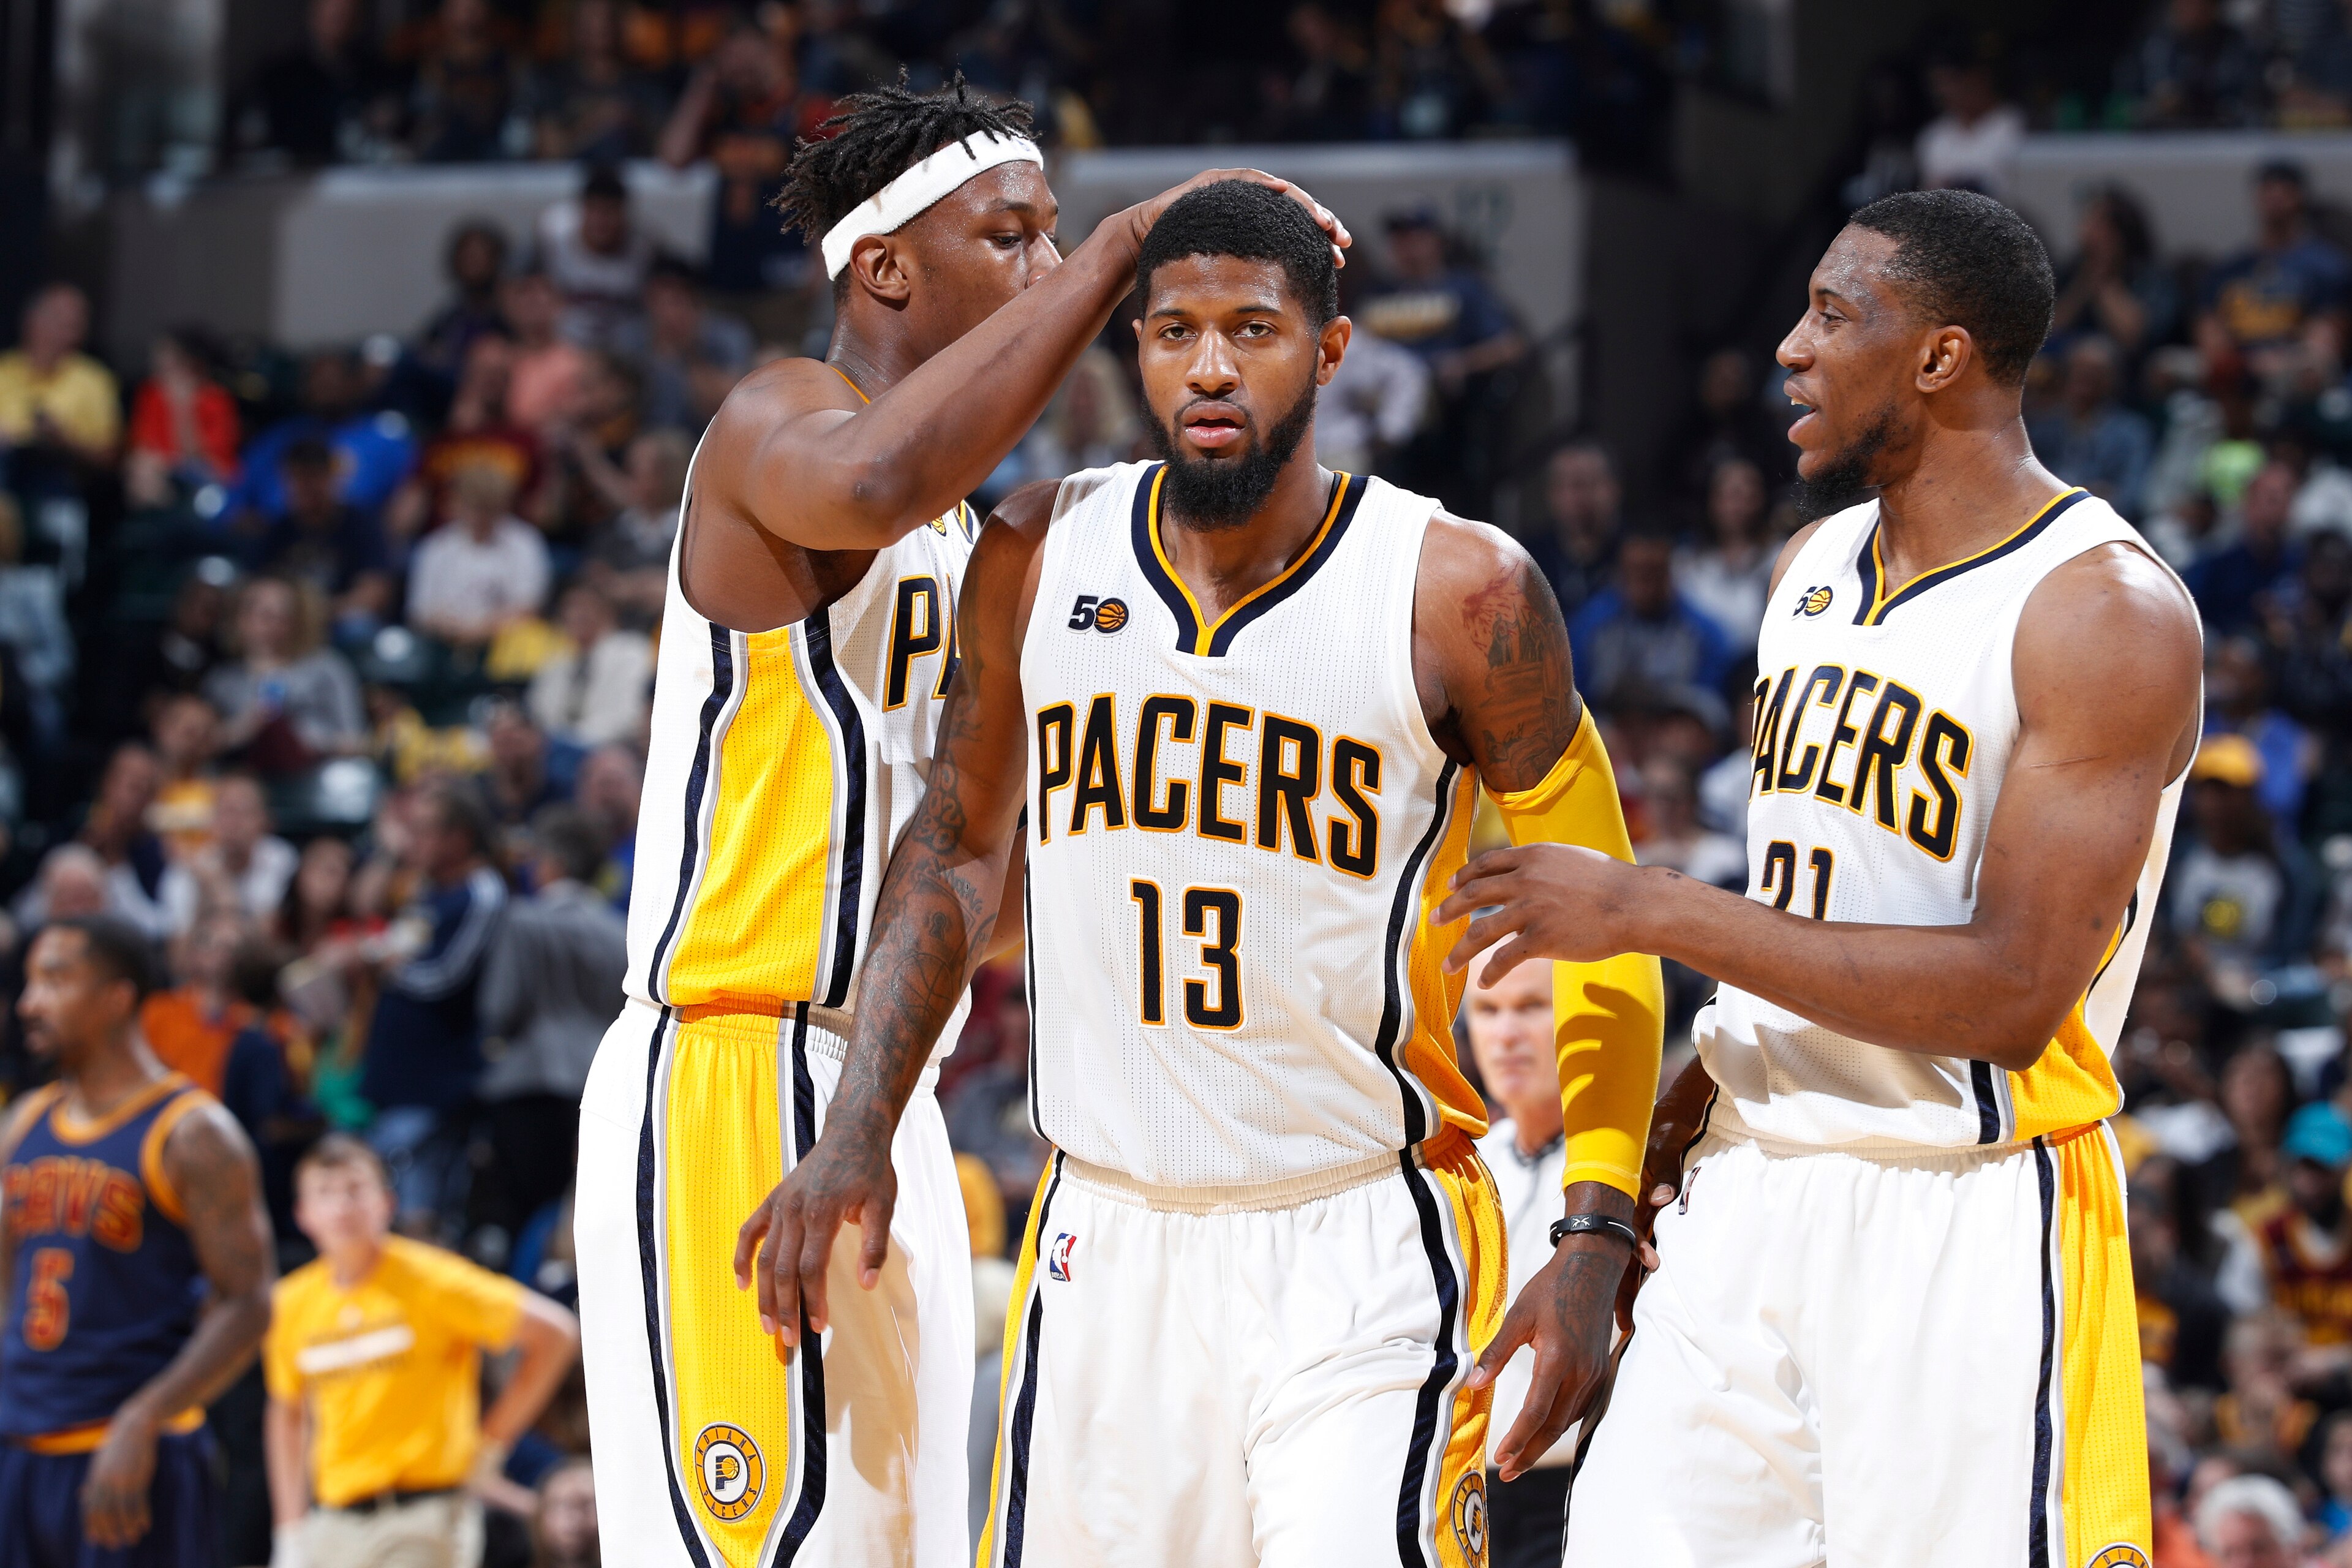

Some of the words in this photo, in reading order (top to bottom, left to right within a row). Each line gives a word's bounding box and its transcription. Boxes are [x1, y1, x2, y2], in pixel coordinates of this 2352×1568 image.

[1036, 692, 1384, 880] PACERS
[1129, 876, 1246, 1030] 13
[1, 1155, 145, 1253] CAVS
[23, 1247, 75, 1351] 5
[696, 1427, 757, 1468] INDIANA
[703, 1487, 757, 1517] PACERS
